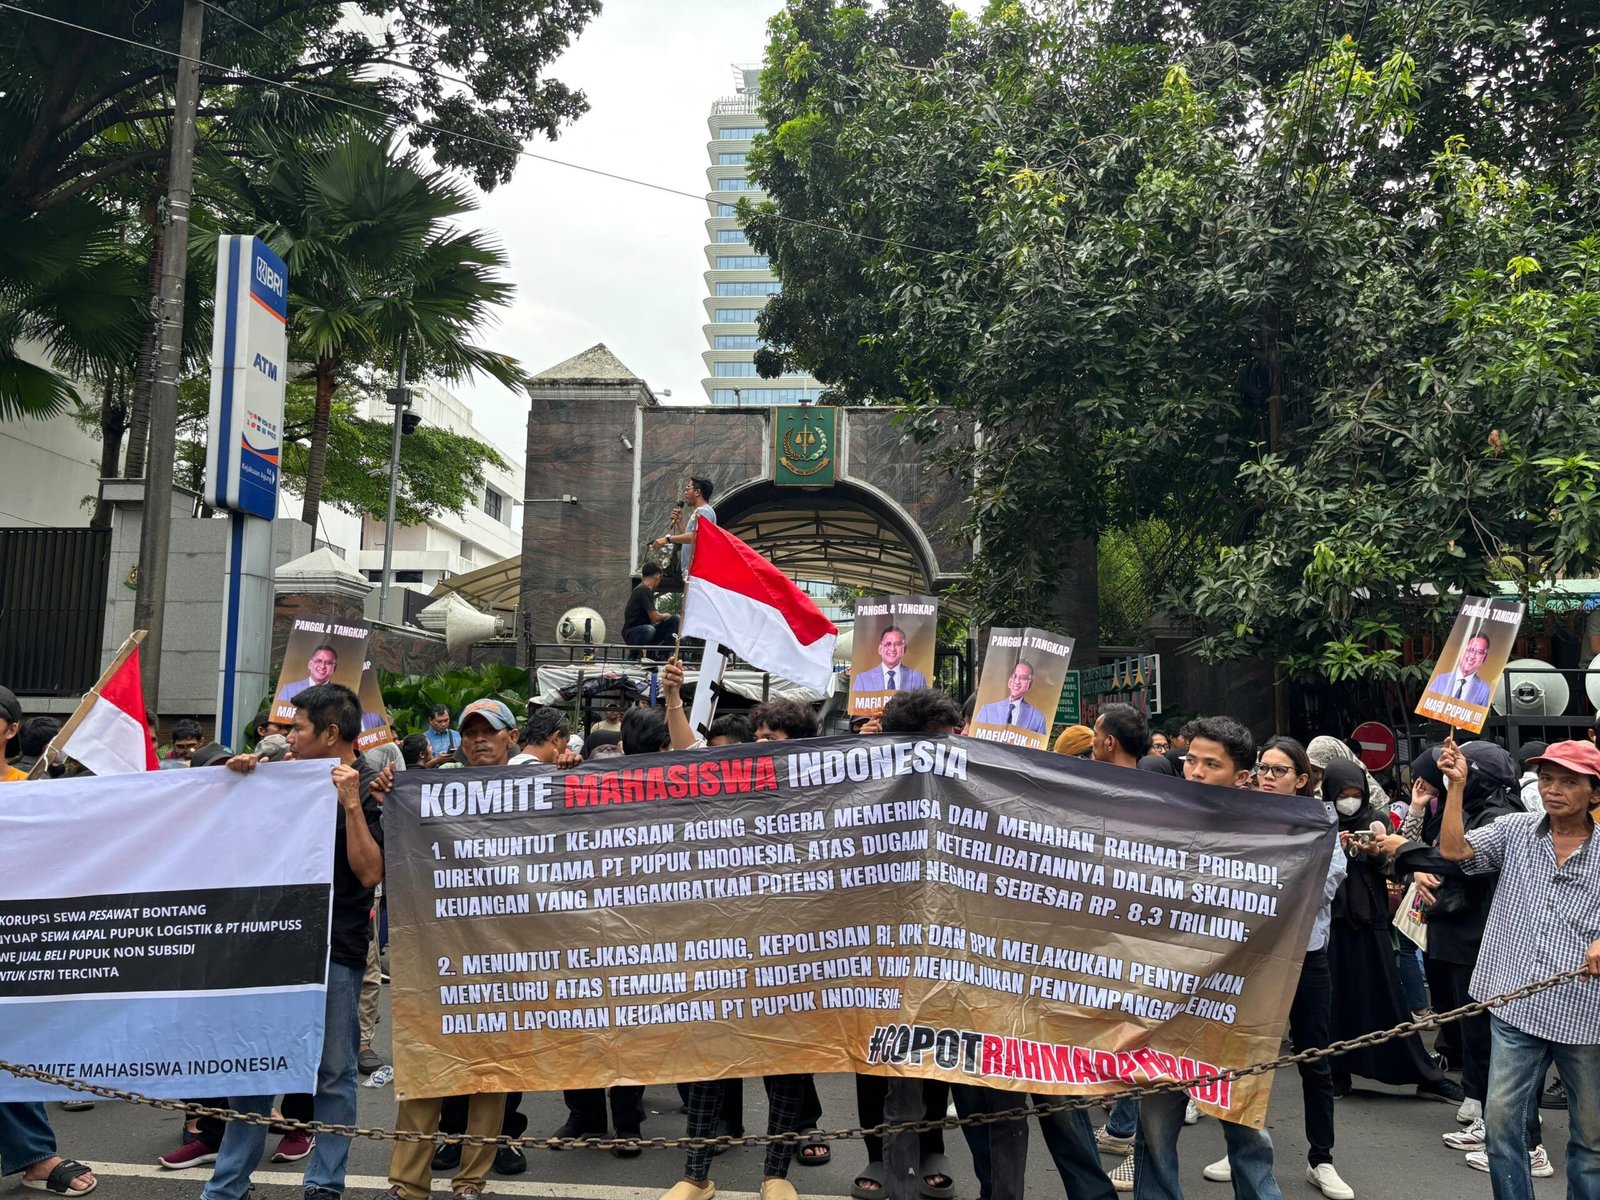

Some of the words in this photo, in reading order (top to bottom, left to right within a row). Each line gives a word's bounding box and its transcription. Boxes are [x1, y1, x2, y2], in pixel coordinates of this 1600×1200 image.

[267, 266, 283, 298] BRI
[253, 352, 278, 381] ATM
[857, 603, 888, 616] PANGGIL
[890, 603, 895, 614] &
[897, 603, 935, 616] TANGKAP
[294, 619, 325, 633] PANGGIL
[333, 624, 369, 640] TANGKAP
[1022, 636, 1029, 647] &
[1030, 636, 1070, 657] TANGKAP
[276, 705, 297, 719] MAF
[855, 696, 882, 709] MAFIA
[358, 733, 378, 746] UPUK
[420, 775, 553, 818] KOMITE
[564, 754, 779, 809] MAHASISWA
[787, 740, 969, 788] INDONESIA
[431, 841, 447, 860] 1.
[454, 833, 556, 860] MENUNTUT
[566, 823, 674, 852] KEJAKSAAN
[684, 817, 746, 842] AGUNG
[754, 810, 825, 836] SEGERA
[833, 798, 942, 828] MEMERIKSA
[948, 805, 989, 831] DAN
[996, 814, 1095, 853] MENAHAN
[1104, 836, 1189, 871] RAHMAT
[1198, 853, 1285, 890] PRIBADI,
[433, 865, 520, 889] DIREKTUR
[526, 859, 595, 884] UTAMA
[602, 857, 625, 878] PT
[631, 851, 692, 876] PUPUK
[697, 842, 802, 871] INDONESIA,
[808, 837, 856, 861] ATAS
[862, 828, 929, 856] DUGAAN
[936, 829, 1106, 887] KETERLIBATANNYA
[1112, 867, 1185, 901] DALAM
[1191, 882, 1278, 918] SKANDAL
[434, 892, 530, 919] KEUANGAN
[535, 888, 588, 912] YANG
[593, 877, 752, 909] MENGAKIBATKAN
[758, 869, 834, 896] POTENSI
[840, 860, 921, 890] KERUGIAN
[926, 858, 989, 895] NEGARA
[994, 875, 1084, 913] SEBESAR
[1087, 894, 1121, 920] RP.
[1127, 901, 1163, 928] 8,3
[1168, 908, 1252, 943] TRILIUN;
[0, 914, 50, 926] KORUPSI
[54, 911, 86, 923] SEWA
[88, 908, 140, 921] PESAWAT
[142, 904, 207, 918] BONTANG
[41, 930, 70, 942] SEWA
[72, 929, 107, 941] KAPAL
[110, 926, 154, 940] PUPUK
[157, 923, 213, 937] LOGISTIK
[214, 923, 224, 934] &
[226, 922, 239, 933] PT
[241, 919, 303, 933] HUMPUSS
[16, 950, 42, 965] JUAL
[43, 949, 67, 961] BELI
[69, 948, 110, 960] PUPUK
[113, 946, 145, 958] NON
[148, 944, 196, 956] SUBSIDI
[437, 956, 457, 977] 2.
[462, 949, 560, 976] MENUNTUT
[567, 941, 678, 970] KEJKASAAN
[684, 937, 754, 961] AGUNG,
[758, 924, 872, 958] KEPOLISIAN
[876, 924, 895, 949] RI,
[899, 922, 923, 946] KPK
[928, 922, 966, 951] DAN
[968, 931, 998, 959] BPK
[1002, 938, 1124, 982] MELAKUKAN
[28, 970, 55, 981] ISTRI
[58, 966, 119, 980] TERCINTA
[440, 980, 549, 1006] MENYELURU
[555, 977, 604, 1001] ATAS
[608, 971, 688, 998] TEMUAN
[693, 968, 748, 992] AUDIT
[754, 956, 873, 988] INDEPENDEN
[877, 955, 911, 978] YANG
[912, 956, 1026, 996] MENUNJUKAN
[1180, 995, 1238, 1025] ERIUS
[441, 1011, 507, 1036] DALAM
[513, 1007, 610, 1032] LAPORAAN
[615, 999, 716, 1028] KEUANGAN
[721, 998, 745, 1020] PT
[751, 990, 817, 1018] PUPUK
[79, 1060, 183, 1079] MAHASISWA
[188, 1055, 289, 1075] INDONESIA
